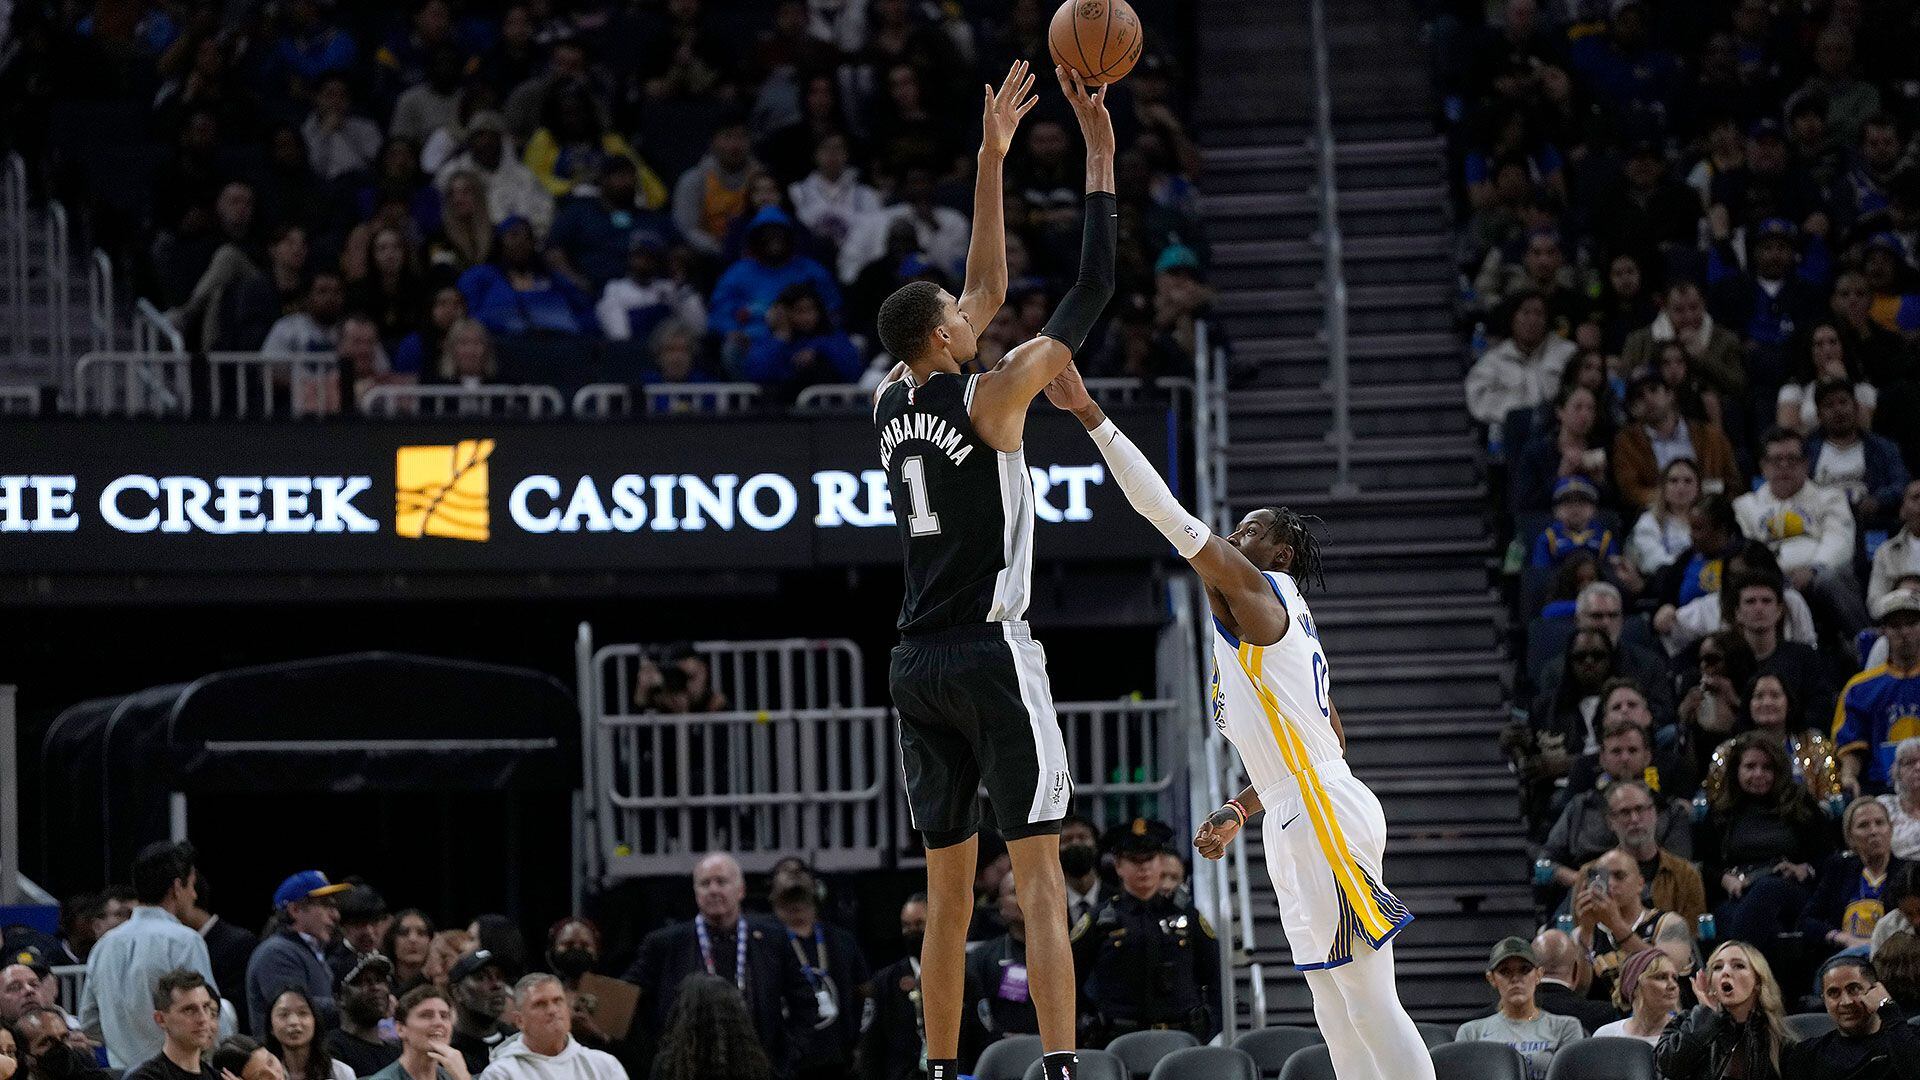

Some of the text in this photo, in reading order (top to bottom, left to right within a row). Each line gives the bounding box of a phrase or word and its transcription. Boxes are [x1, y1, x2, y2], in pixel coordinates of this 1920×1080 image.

[99, 475, 379, 534] CREEK
[509, 474, 797, 533] CASINO
[901, 455, 942, 538] 1
